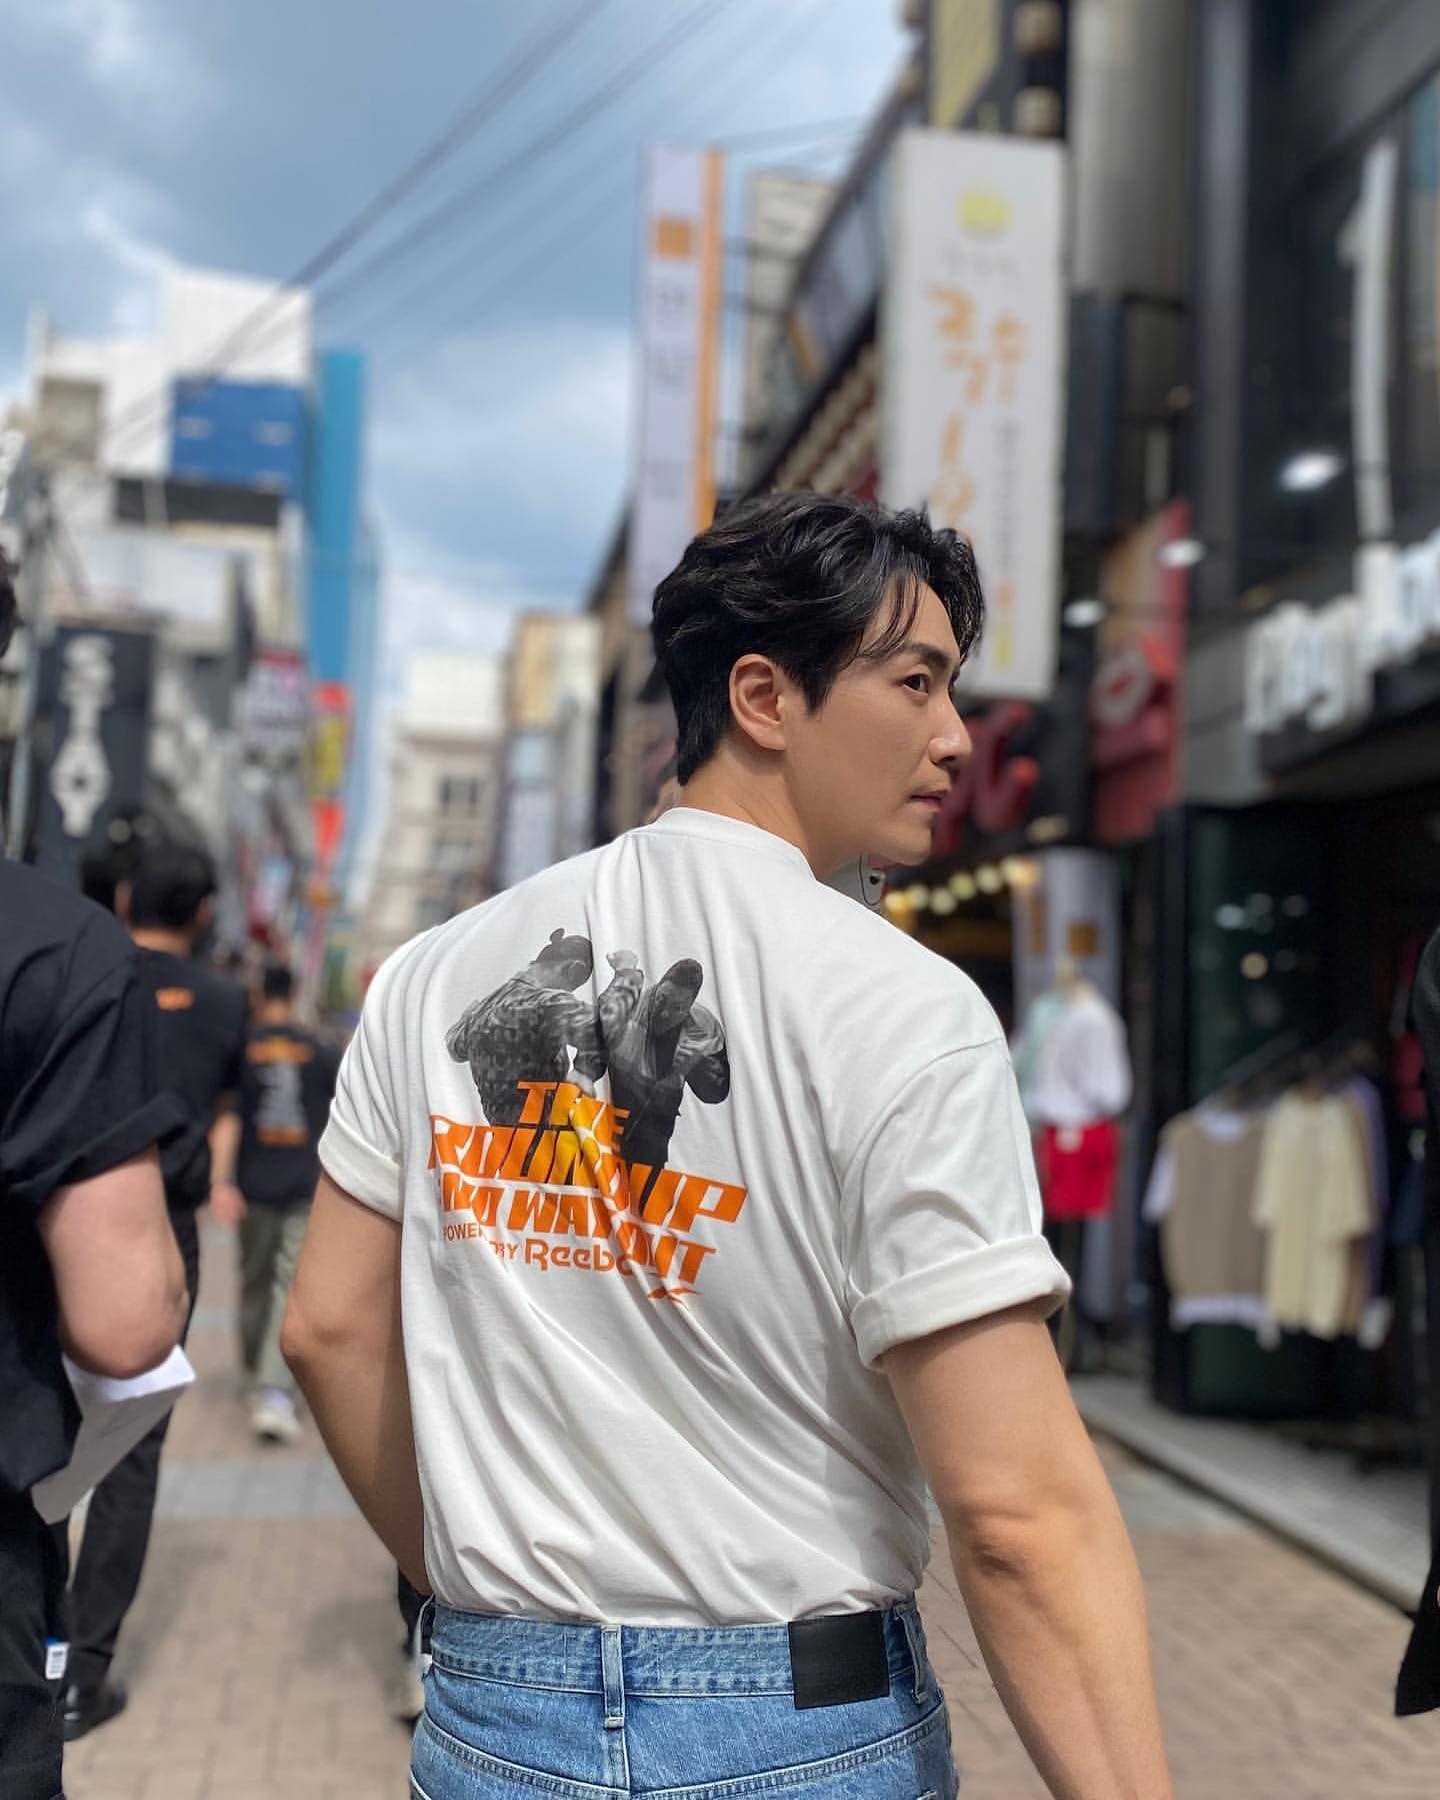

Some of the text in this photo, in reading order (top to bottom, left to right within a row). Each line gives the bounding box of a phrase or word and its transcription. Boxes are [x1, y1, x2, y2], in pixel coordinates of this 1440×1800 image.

[441, 1172, 506, 1228] NO
[506, 1188, 613, 1242] WAY
[525, 1238, 634, 1276] Reebo
